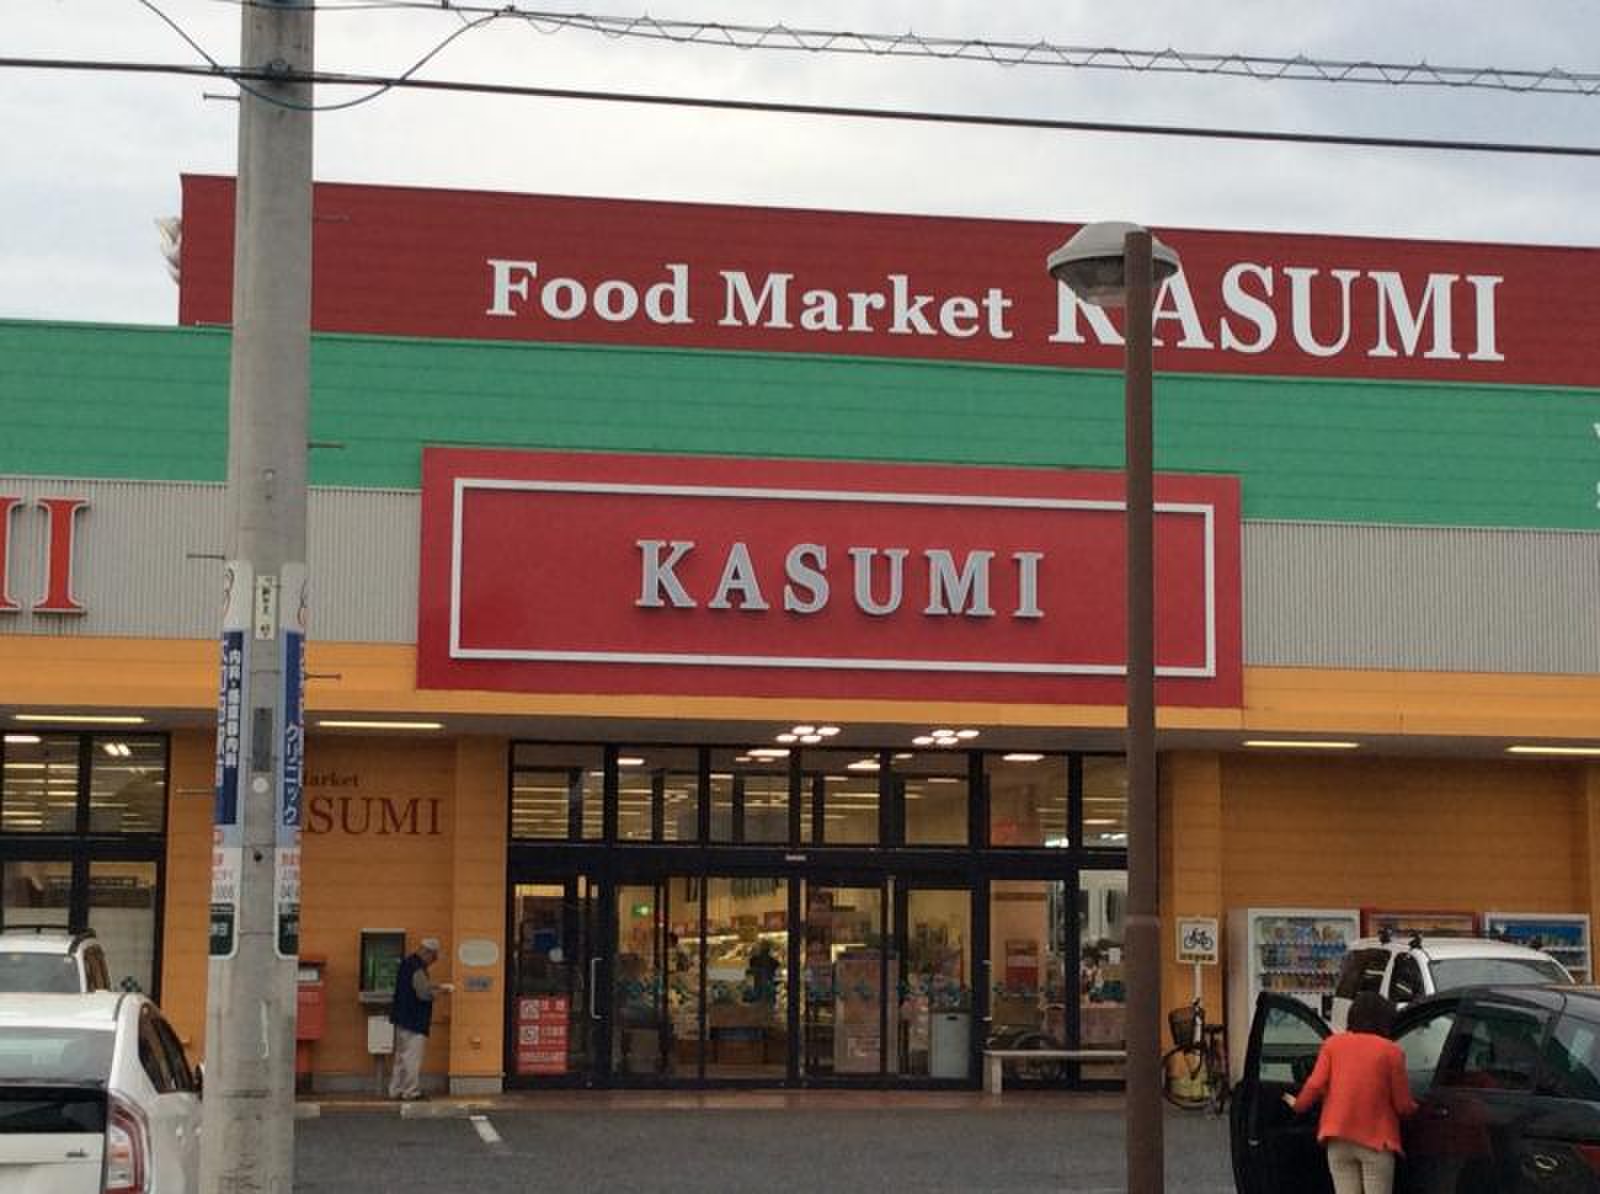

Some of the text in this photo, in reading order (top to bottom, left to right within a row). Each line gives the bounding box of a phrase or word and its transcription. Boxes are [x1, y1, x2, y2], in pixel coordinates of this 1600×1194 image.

[486, 258, 694, 325] Food
[718, 270, 1013, 340] Market
[635, 539, 1045, 618] KASUMI
[298, 797, 444, 836] SUMI
